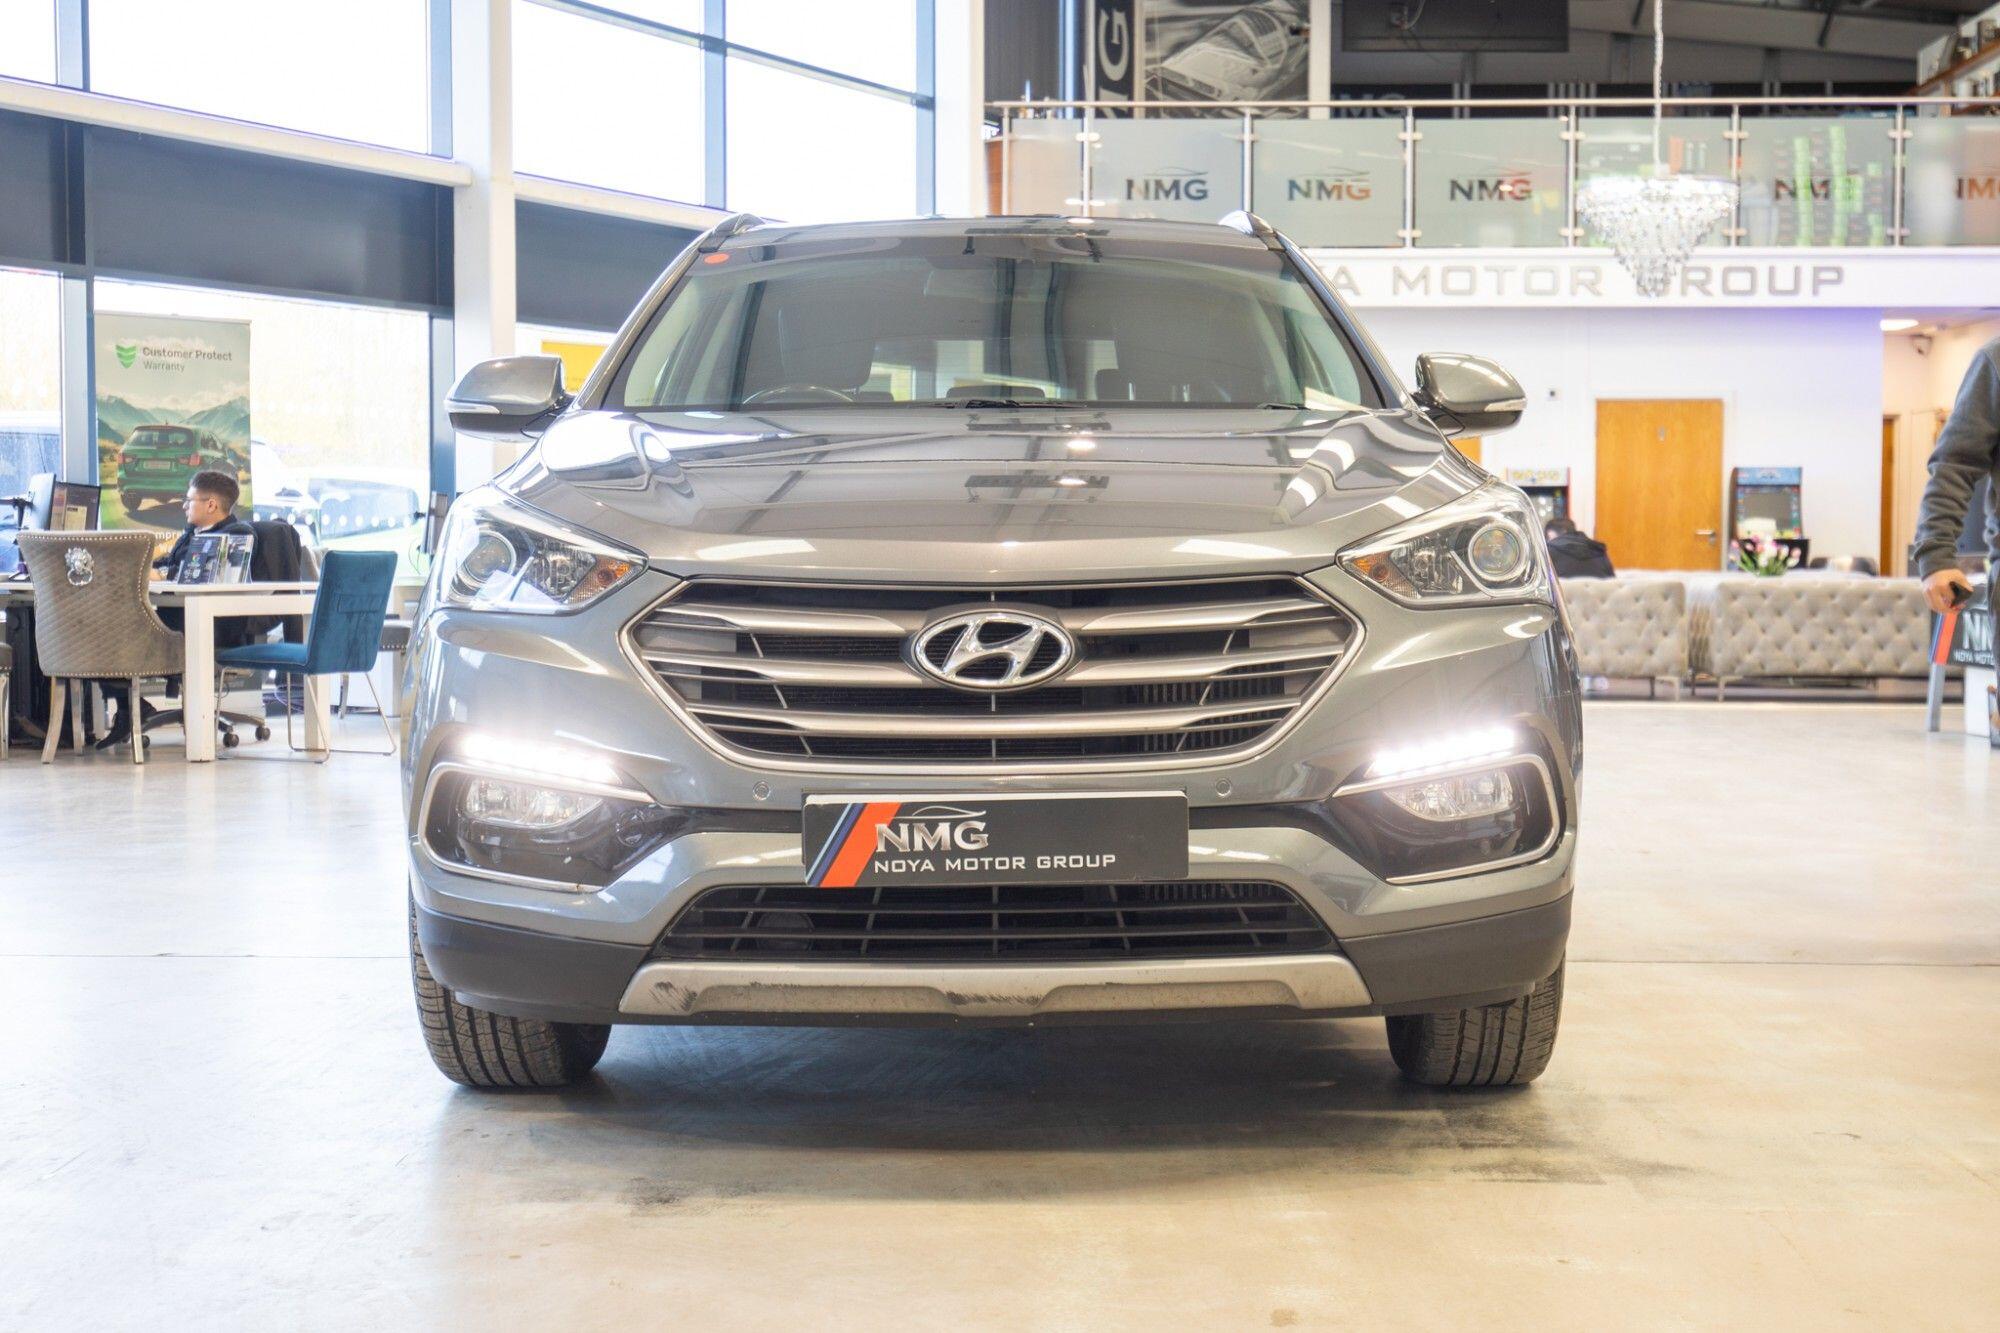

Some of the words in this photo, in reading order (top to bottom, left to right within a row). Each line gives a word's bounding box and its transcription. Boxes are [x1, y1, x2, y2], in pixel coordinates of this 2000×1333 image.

[1126, 178, 1209, 201] NMG
[1287, 178, 1372, 201] NMG
[1449, 178, 1533, 202] NMG
[1774, 178, 1862, 200] NM
[1392, 264, 1605, 297] MOTOR
[1636, 265, 1845, 297] ROUP
[142, 346, 193, 360] Customer
[195, 349, 233, 362] Protect
[143, 361, 185, 372] Warranty
[875, 820, 989, 853] NMG
[874, 859, 936, 874] NOYA
[945, 856, 1026, 871] MOTOR
[1036, 854, 1116, 870] GROUP
